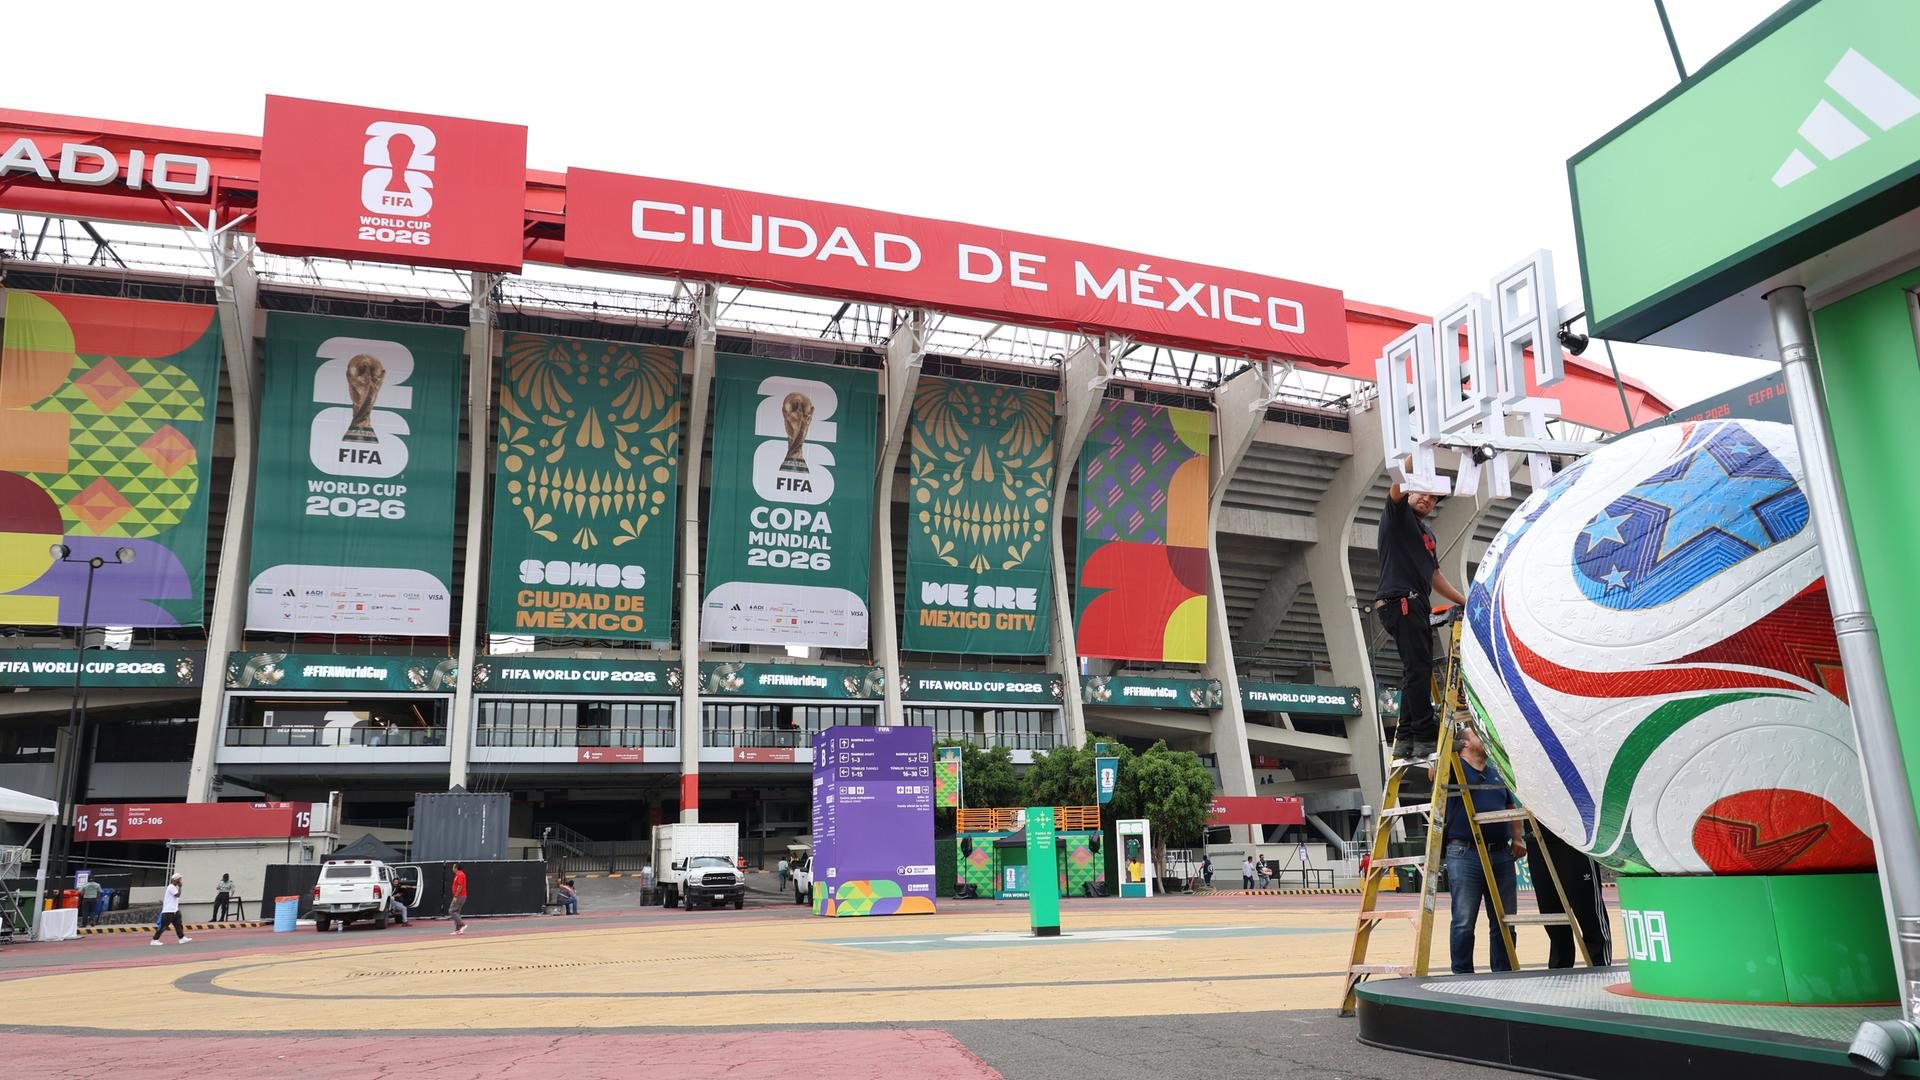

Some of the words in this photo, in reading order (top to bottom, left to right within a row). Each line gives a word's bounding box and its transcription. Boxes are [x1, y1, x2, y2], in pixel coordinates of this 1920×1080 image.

[382, 195, 413, 208] FIFA
[360, 216, 404, 229] WORLD
[407, 220, 431, 230] CUP
[358, 226, 431, 246] 2026
[631, 199, 922, 272] CIUDAD
[958, 243, 1048, 292] DE
[1074, 260, 1305, 334] MÉXICO
[1747, 387, 1774, 407] FIFA
[338, 448, 382, 465] FIFA
[307, 480, 370, 495] WORLD
[372, 484, 407, 497] CUP
[776, 477, 813, 493] FIFA
[305, 495, 406, 520] 2026
[750, 506, 832, 534] COPA
[748, 531, 832, 550] MUNDIAL
[747, 548, 832, 571] 2026
[519, 559, 646, 590] SOMOS
[517, 589, 611, 611] CIUDAD
[614, 594, 645, 612] DE
[921, 581, 969, 608] WE
[973, 585, 1038, 611] ARE
[516, 608, 644, 632] MÉXICO
[919, 608, 991, 630] MEXICO
[995, 612, 1036, 631] CITY
[0, 661, 30, 673] FIFA
[86, 662, 115, 674] CUP
[115, 662, 165, 674] 2026
[303, 665, 388, 681] #FIFAWorldCup
[501, 668, 531, 680] FIFA
[532, 669, 582, 681] WORLD
[583, 670, 609, 681] CUP
[610, 671, 656, 682] 2026
[758, 673, 828, 689] #FIFAWorldCup
[919, 679, 943, 690] FIFA
[943, 680, 983, 691] WORLD
[983, 682, 1005, 692] CUP
[1006, 682, 1043, 693] 2026
[1123, 686, 1177, 699] #FIFAWorldCup
[1249, 691, 1268, 701] FIFA
[1268, 692, 1299, 702] WORLD
[1299, 694, 1316, 703] CUP
[1317, 695, 1346, 705] 2026
[583, 751, 590, 760] 4
[738, 751, 745, 760] 4
[78, 815, 88, 832] 15
[94, 818, 118, 837] 15
[128, 817, 163, 825] 103-106
[296, 812, 310, 828] 15
